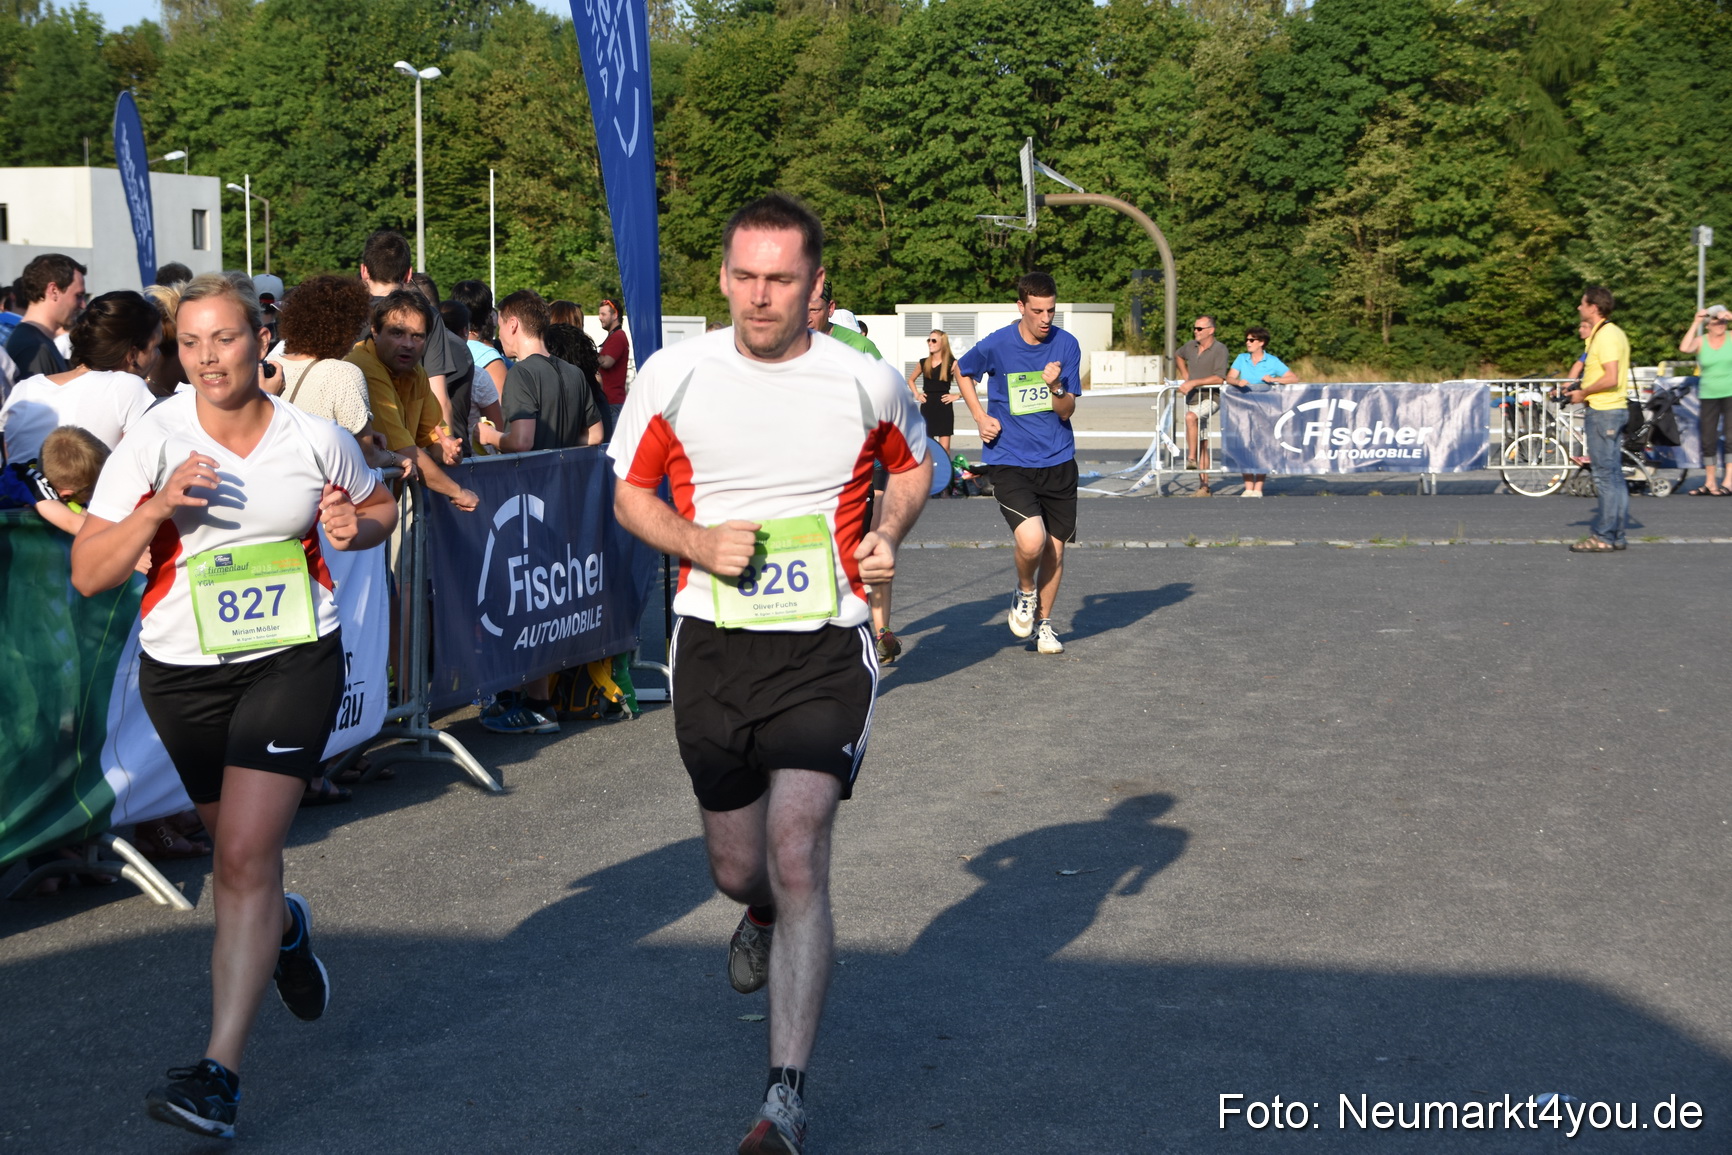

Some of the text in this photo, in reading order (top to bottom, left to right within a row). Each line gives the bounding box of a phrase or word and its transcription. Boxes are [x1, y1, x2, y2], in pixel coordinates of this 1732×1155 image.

[1018, 386, 1049, 402] 735
[1303, 420, 1433, 446] Fischer
[1314, 447, 1423, 460] AUTOMOBILE
[208, 562, 249, 575] firmenlauf
[737, 560, 810, 597] 826
[217, 583, 287, 623] 827
[752, 602, 774, 610] Oliver
[232, 624, 280, 636] Miriam Mößler
[513, 604, 603, 650] AUTOMOBILE
